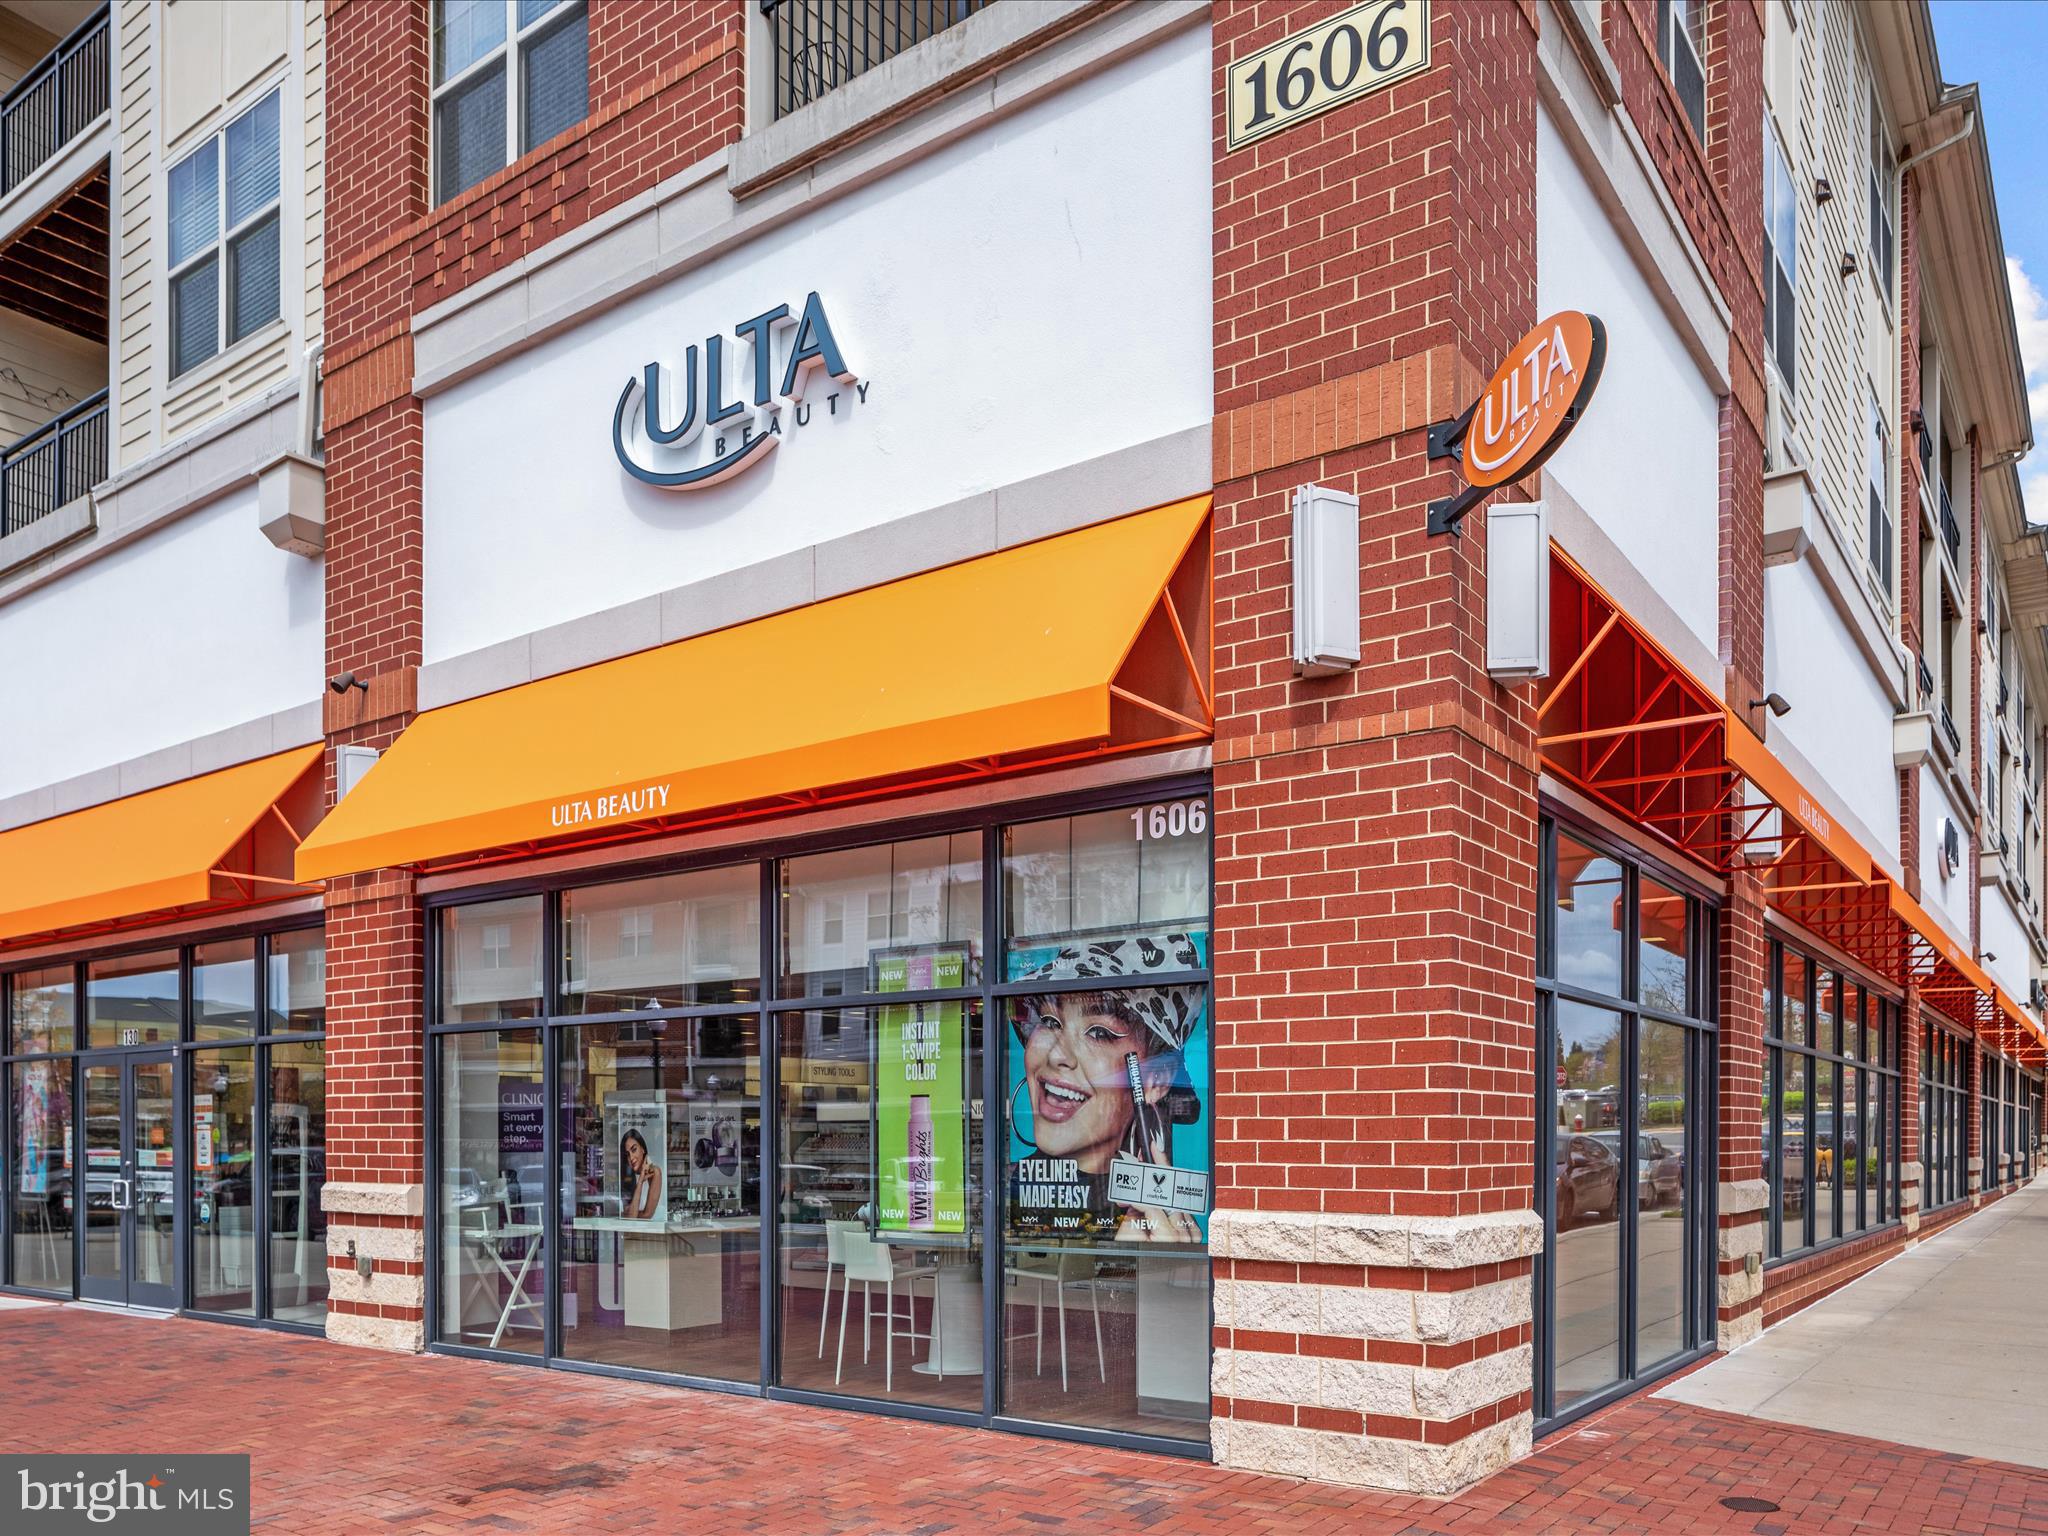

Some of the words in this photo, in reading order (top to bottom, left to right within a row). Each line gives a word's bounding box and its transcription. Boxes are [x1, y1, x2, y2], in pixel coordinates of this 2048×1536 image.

[1244, 0, 1409, 130] 1606
[644, 290, 849, 445] ULTA
[1484, 325, 1574, 446] ULTA
[1509, 369, 1578, 443] BEAUTY
[715, 380, 870, 458] BEAUTY
[551, 801, 593, 827] ULTA
[597, 784, 670, 819] BEAUTY
[1130, 799, 1207, 841] 1606
[881, 970, 903, 981] NEW
[936, 965, 960, 977] NEW
[124, 1030, 139, 1045] 130
[902, 1021, 940, 1041] INSTANT
[902, 1042, 941, 1061] 1-SWIPE
[813, 1066, 837, 1077] STYLING
[838, 1067, 856, 1078] TOOLS
[905, 1063, 937, 1081] COLOR
[503, 1112, 536, 1122] Smart
[503, 1124, 514, 1133] at
[515, 1124, 544, 1135] every
[503, 1135, 529, 1145] step.
[1019, 1159, 1079, 1183] EYELINER
[914, 1180, 928, 1221] VIVID
[1019, 1184, 1056, 1208] MADE
[1057, 1185, 1090, 1209] EASY
[881, 1208, 904, 1220] NEW
[938, 1210, 962, 1221] NEW
[1053, 1216, 1080, 1228] NEW
[1131, 1219, 1159, 1230] NEW
